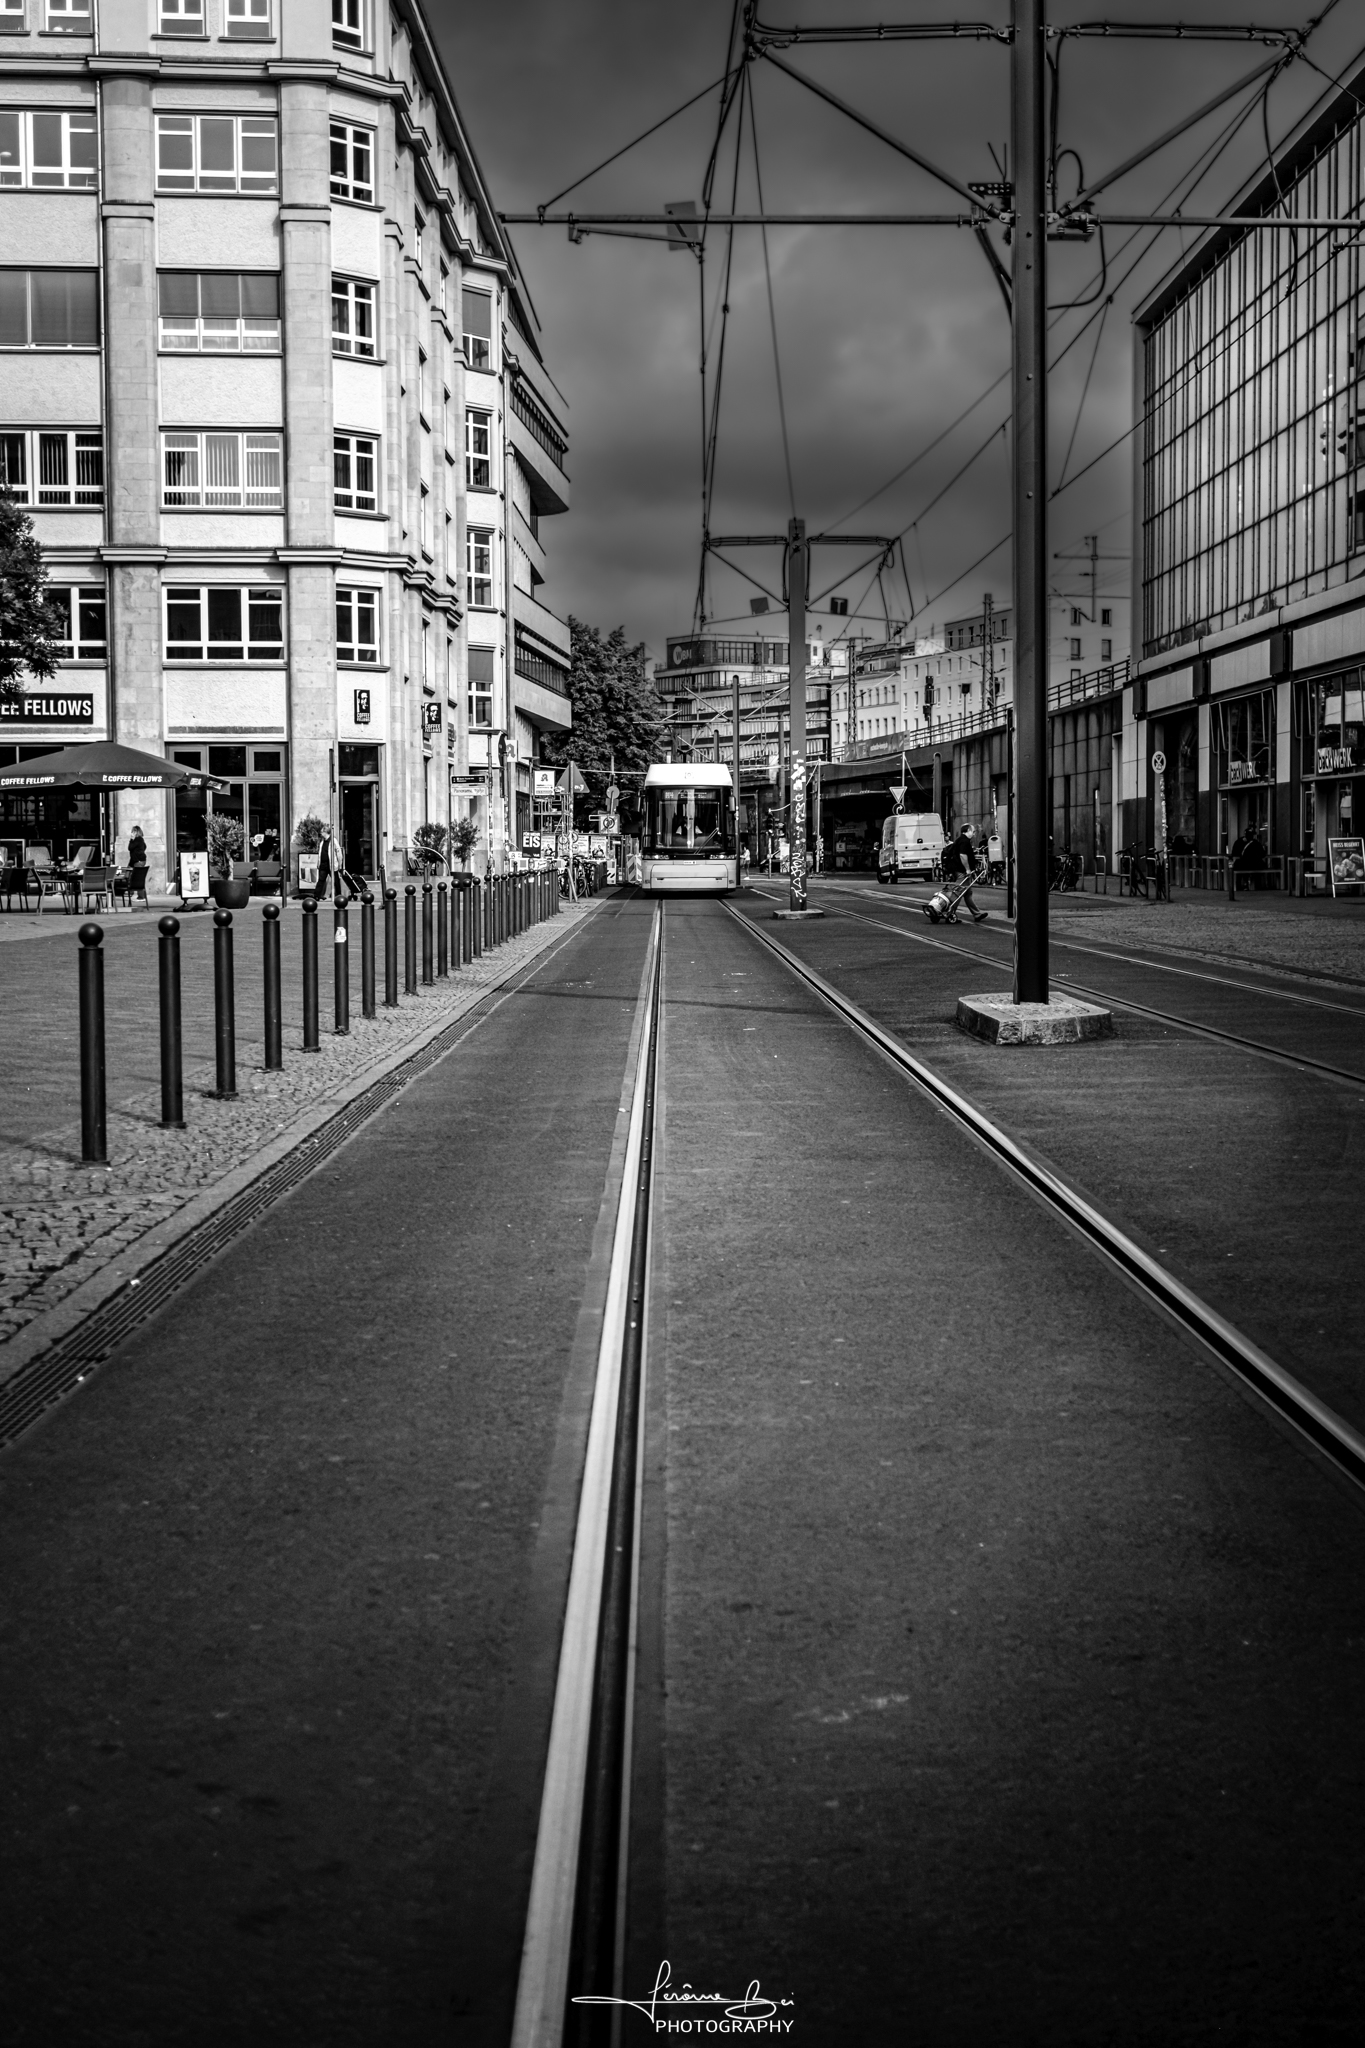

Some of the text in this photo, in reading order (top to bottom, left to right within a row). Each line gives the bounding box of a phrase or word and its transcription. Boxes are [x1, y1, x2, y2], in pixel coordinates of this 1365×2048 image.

[24, 699, 92, 717] FELLOWS
[0, 776, 55, 786] COFFEE FELLOWS
[133, 775, 163, 783] FELLOWS
[523, 836, 541, 848] EIS
